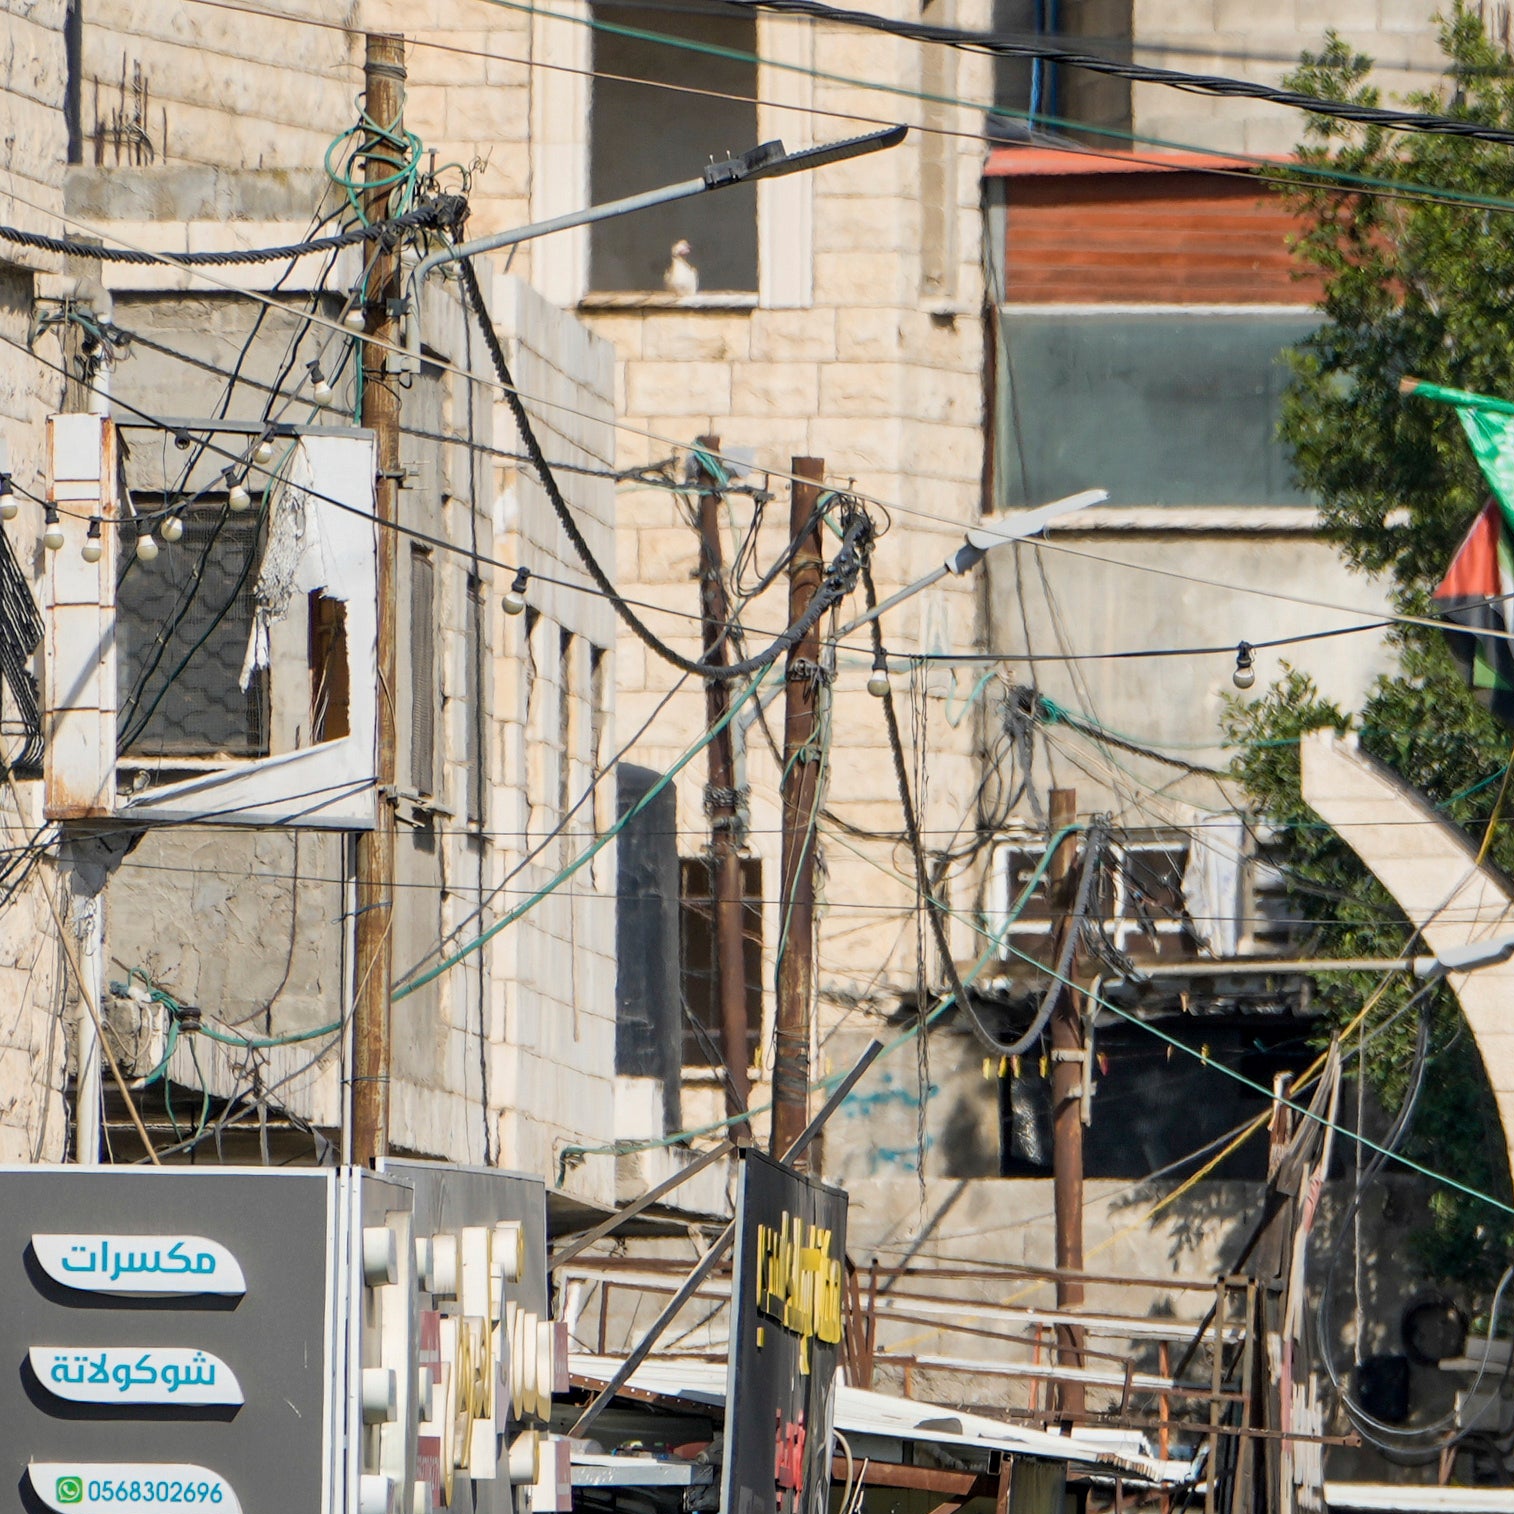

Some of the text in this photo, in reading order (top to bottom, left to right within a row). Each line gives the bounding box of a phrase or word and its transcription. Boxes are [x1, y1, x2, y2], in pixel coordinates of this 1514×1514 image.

[61, 1240, 218, 1282] مكسرات
[50, 1350, 217, 1393] شوكولاتة
[87, 1479, 224, 1504] 0568302696
